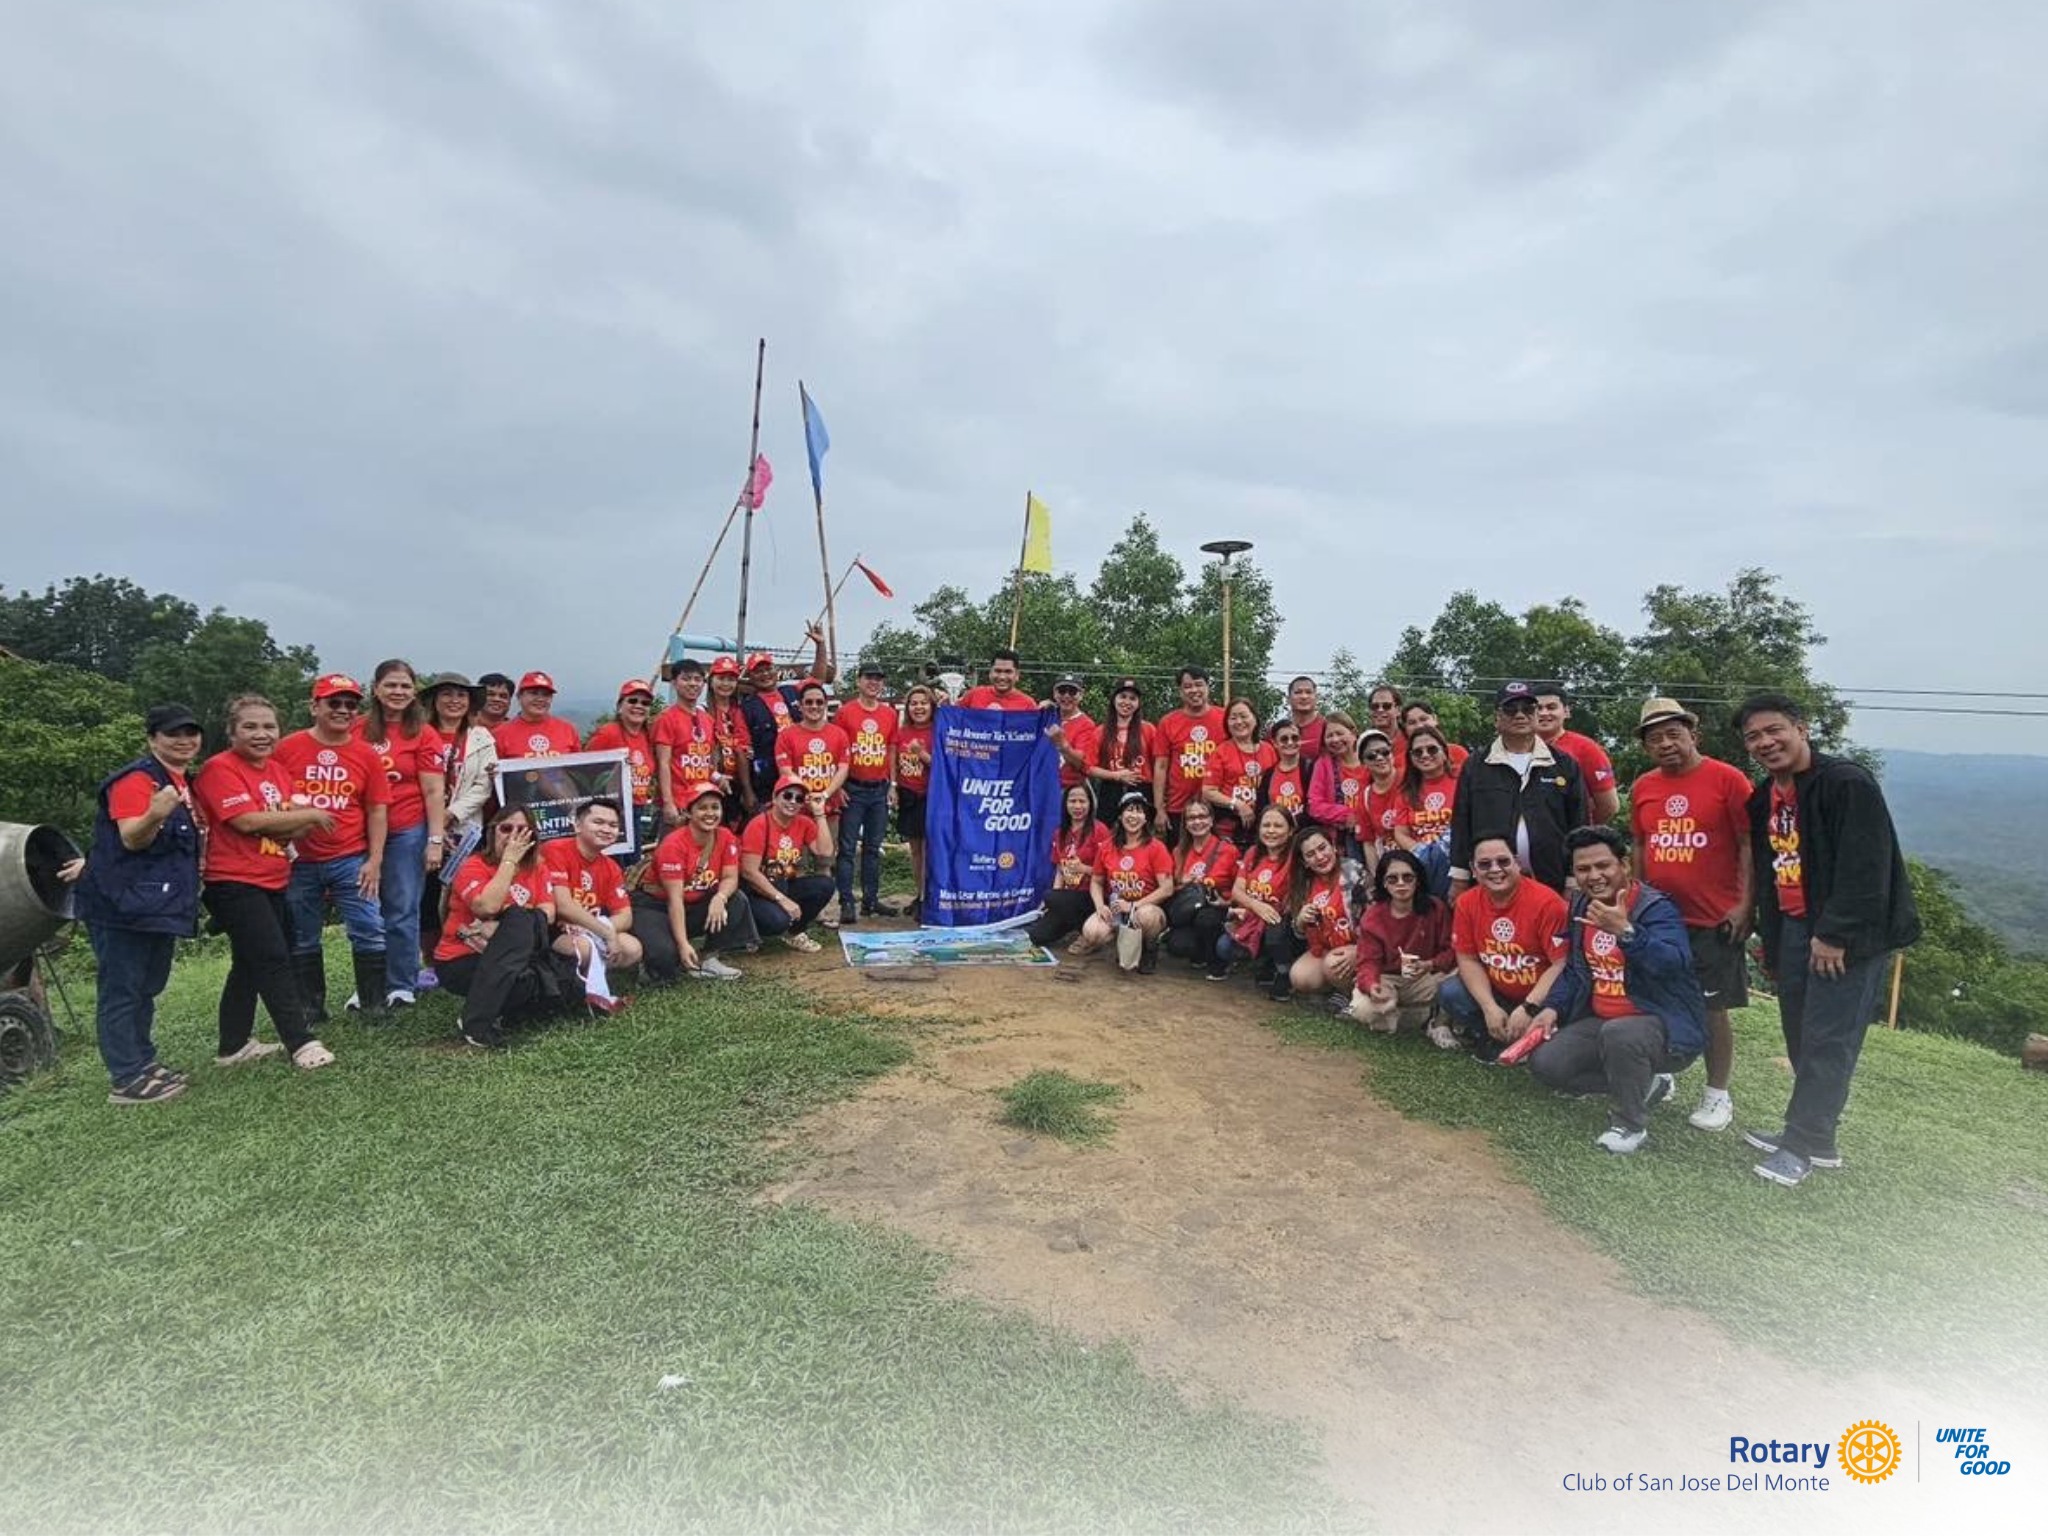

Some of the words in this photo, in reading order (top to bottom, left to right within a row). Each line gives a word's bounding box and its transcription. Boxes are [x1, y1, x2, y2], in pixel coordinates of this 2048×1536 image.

[857, 731, 884, 745] END
[1185, 740, 1216, 756] END
[803, 752, 833, 766] END
[853, 755, 885, 766] NOW
[305, 765, 348, 781] END
[961, 778, 1014, 796] UNITE
[979, 798, 1014, 814] FOR
[985, 813, 1031, 831] GOOD
[1657, 818, 1696, 834] END
[1650, 832, 1708, 848] POLIO
[1654, 847, 1695, 863] NOW
[1489, 965, 1537, 985] NOW
